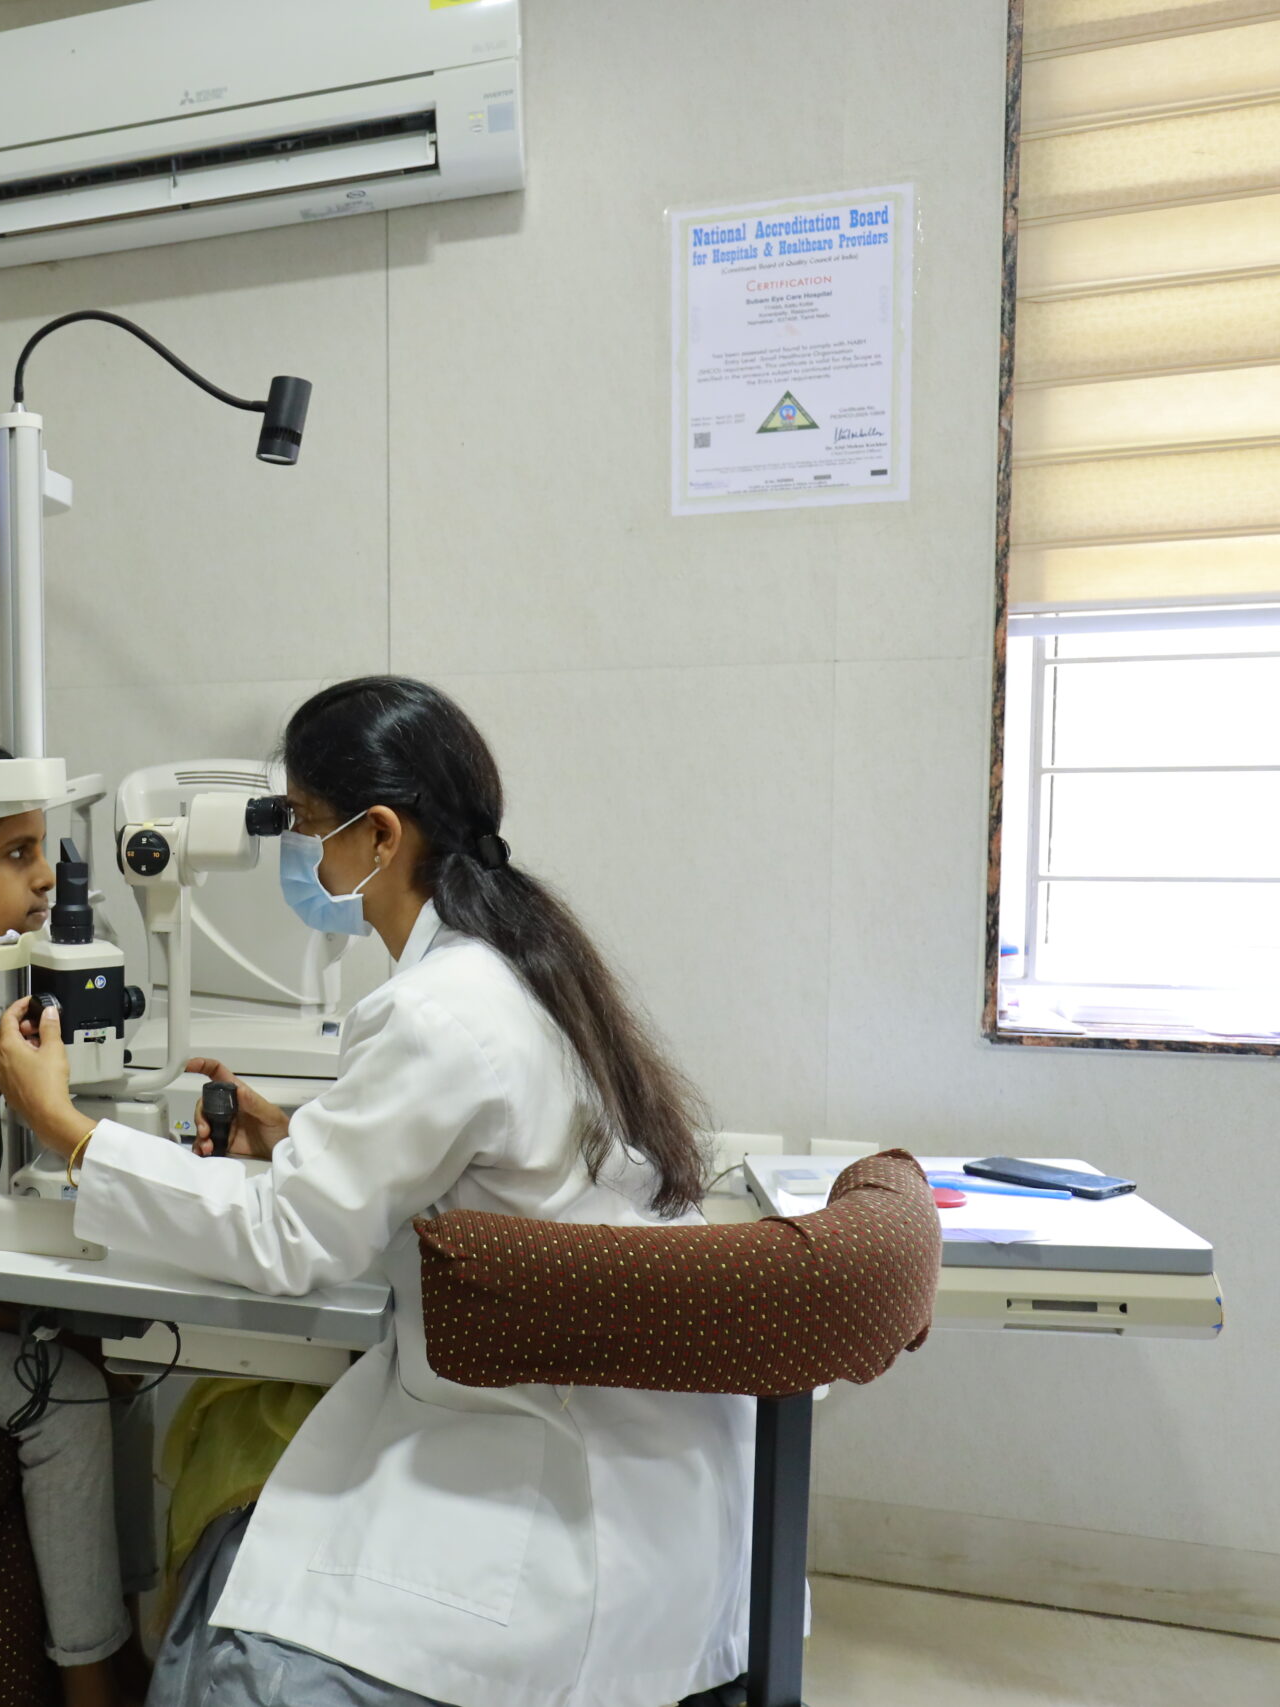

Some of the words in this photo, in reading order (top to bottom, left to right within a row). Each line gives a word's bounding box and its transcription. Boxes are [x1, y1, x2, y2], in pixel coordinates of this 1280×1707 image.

[693, 223, 746, 247] National
[755, 213, 840, 239] Accreditation
[849, 205, 889, 228] Board
[692, 251, 707, 266] for
[712, 245, 757, 265] Hospitals
[764, 242, 773, 257] &
[779, 237, 833, 255] Healthcare
[839, 231, 888, 249] Providers
[804, 291, 832, 299] Hospital
